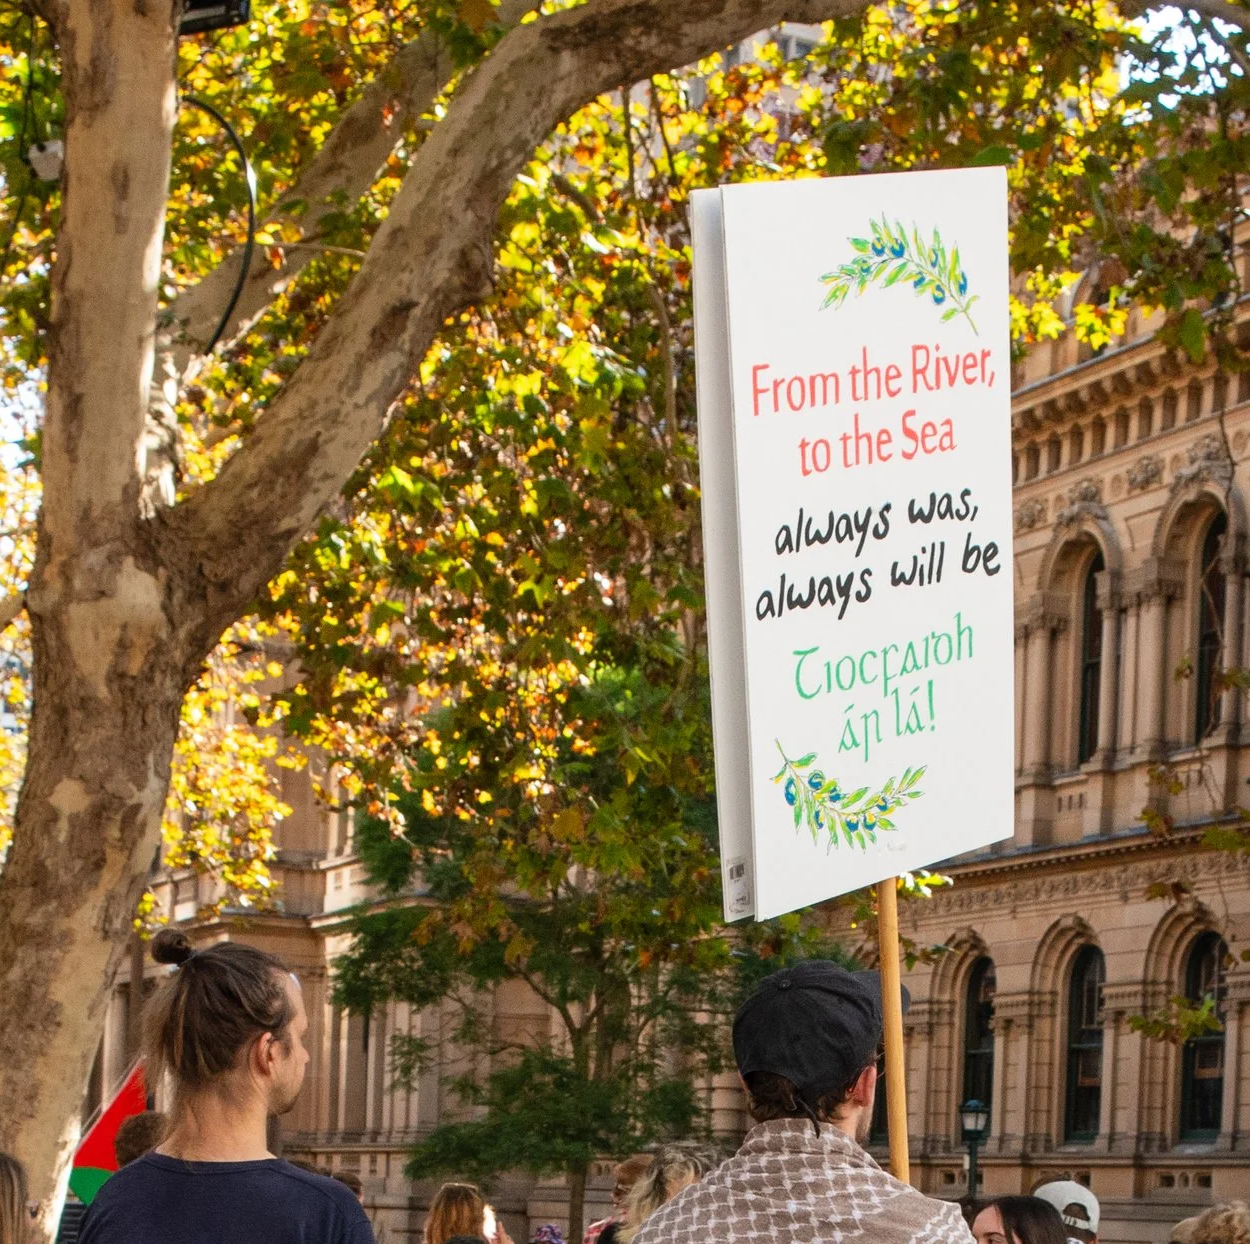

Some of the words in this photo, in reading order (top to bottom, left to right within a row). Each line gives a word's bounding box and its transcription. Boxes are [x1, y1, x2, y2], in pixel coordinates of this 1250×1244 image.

[752, 363, 840, 416] From
[848, 345, 902, 402] the
[911, 343, 996, 394] River,
[798, 436, 831, 477] to
[839, 412, 893, 468] the
[901, 409, 957, 460] Sea
[775, 502, 891, 557] always
[908, 488, 978, 524] was,
[756, 567, 873, 620] always
[891, 541, 945, 586] will
[962, 532, 1001, 576] be
